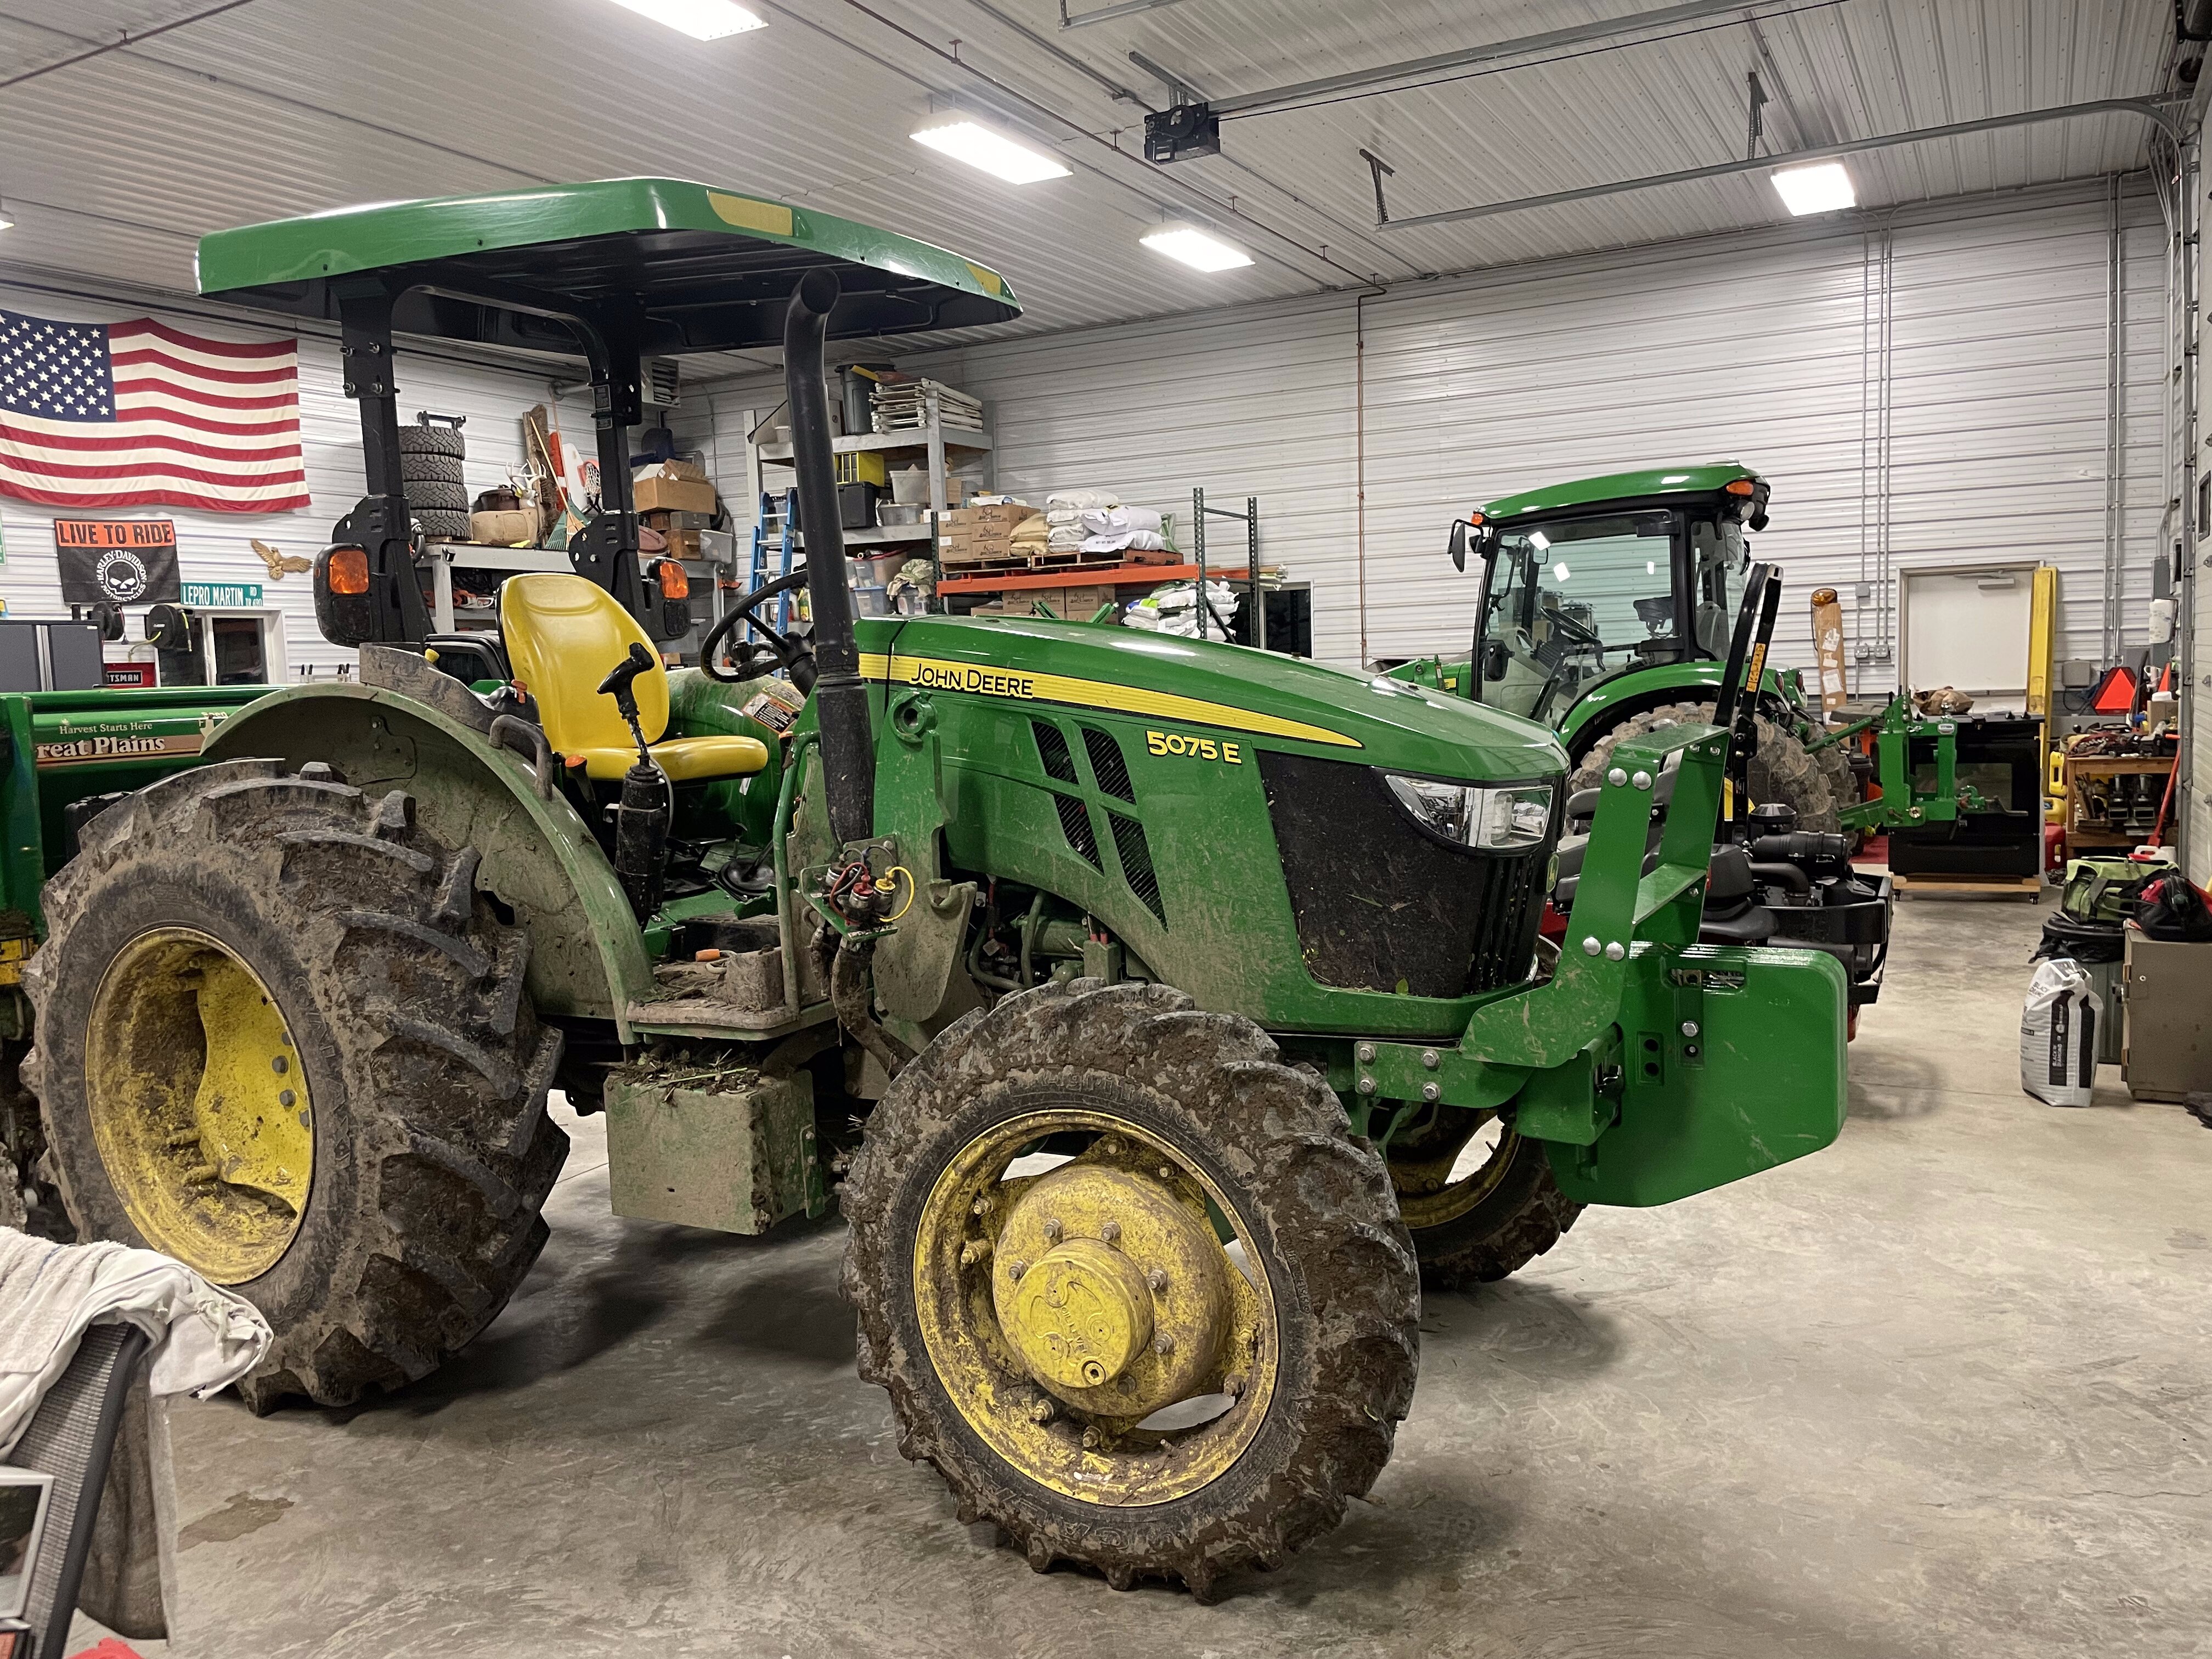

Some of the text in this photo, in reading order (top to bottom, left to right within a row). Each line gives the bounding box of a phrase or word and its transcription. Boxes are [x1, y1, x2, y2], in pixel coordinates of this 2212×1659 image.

[59, 523, 172, 544] LIVE TO RIDE
[100, 583, 146, 602] MOTORCYCLES
[183, 585, 244, 606] LEPRO MARTIN
[250, 586, 257, 597] RD
[911, 663, 1034, 696] JOHN DEERE
[59, 722, 153, 735] Harvest Starts Here
[36, 735, 165, 759] reat Plains
[1146, 730, 1218, 761] 5075
